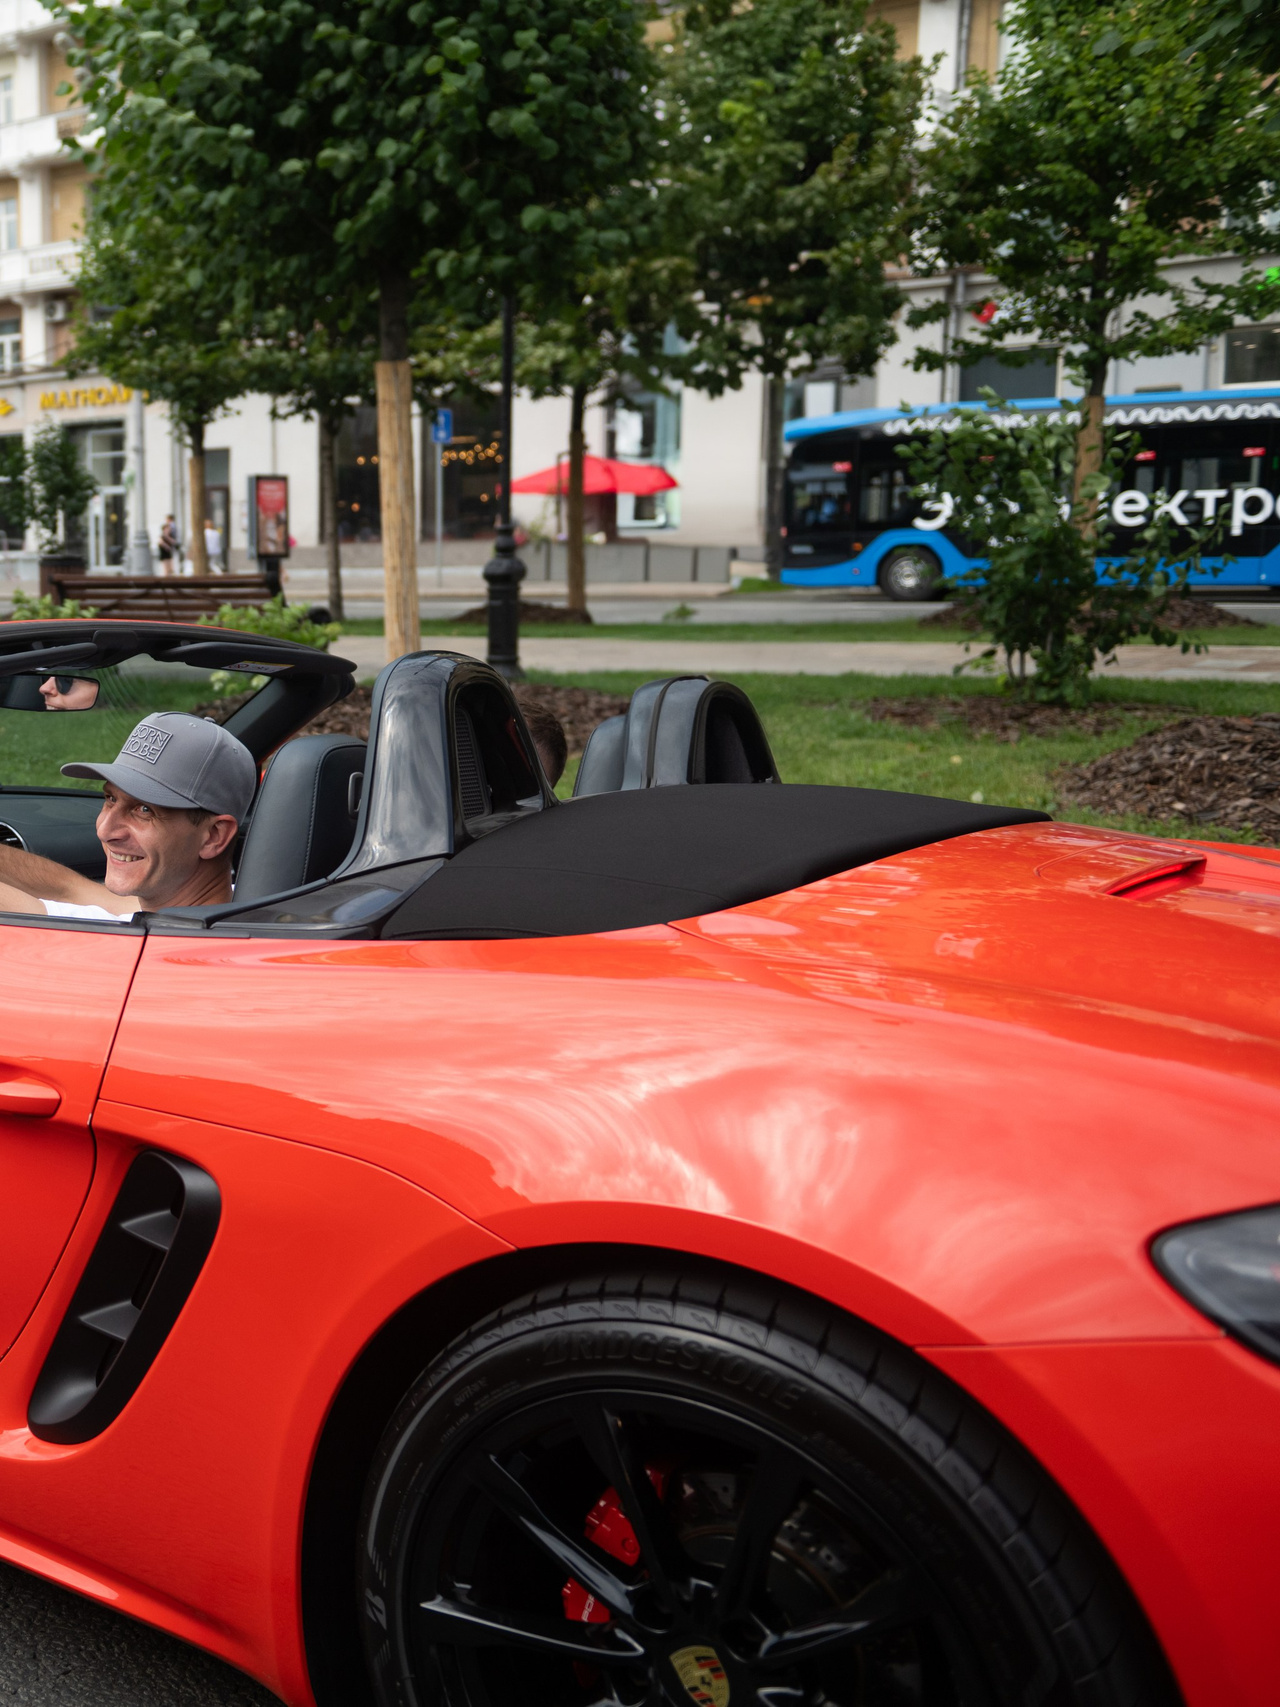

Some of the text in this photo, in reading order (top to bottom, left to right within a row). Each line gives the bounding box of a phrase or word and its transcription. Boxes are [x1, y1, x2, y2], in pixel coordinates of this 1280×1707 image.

[39, 384, 150, 411] МАГНОЛИ
[131, 726, 169, 747] BORN
[139, 742, 161, 760] BE
